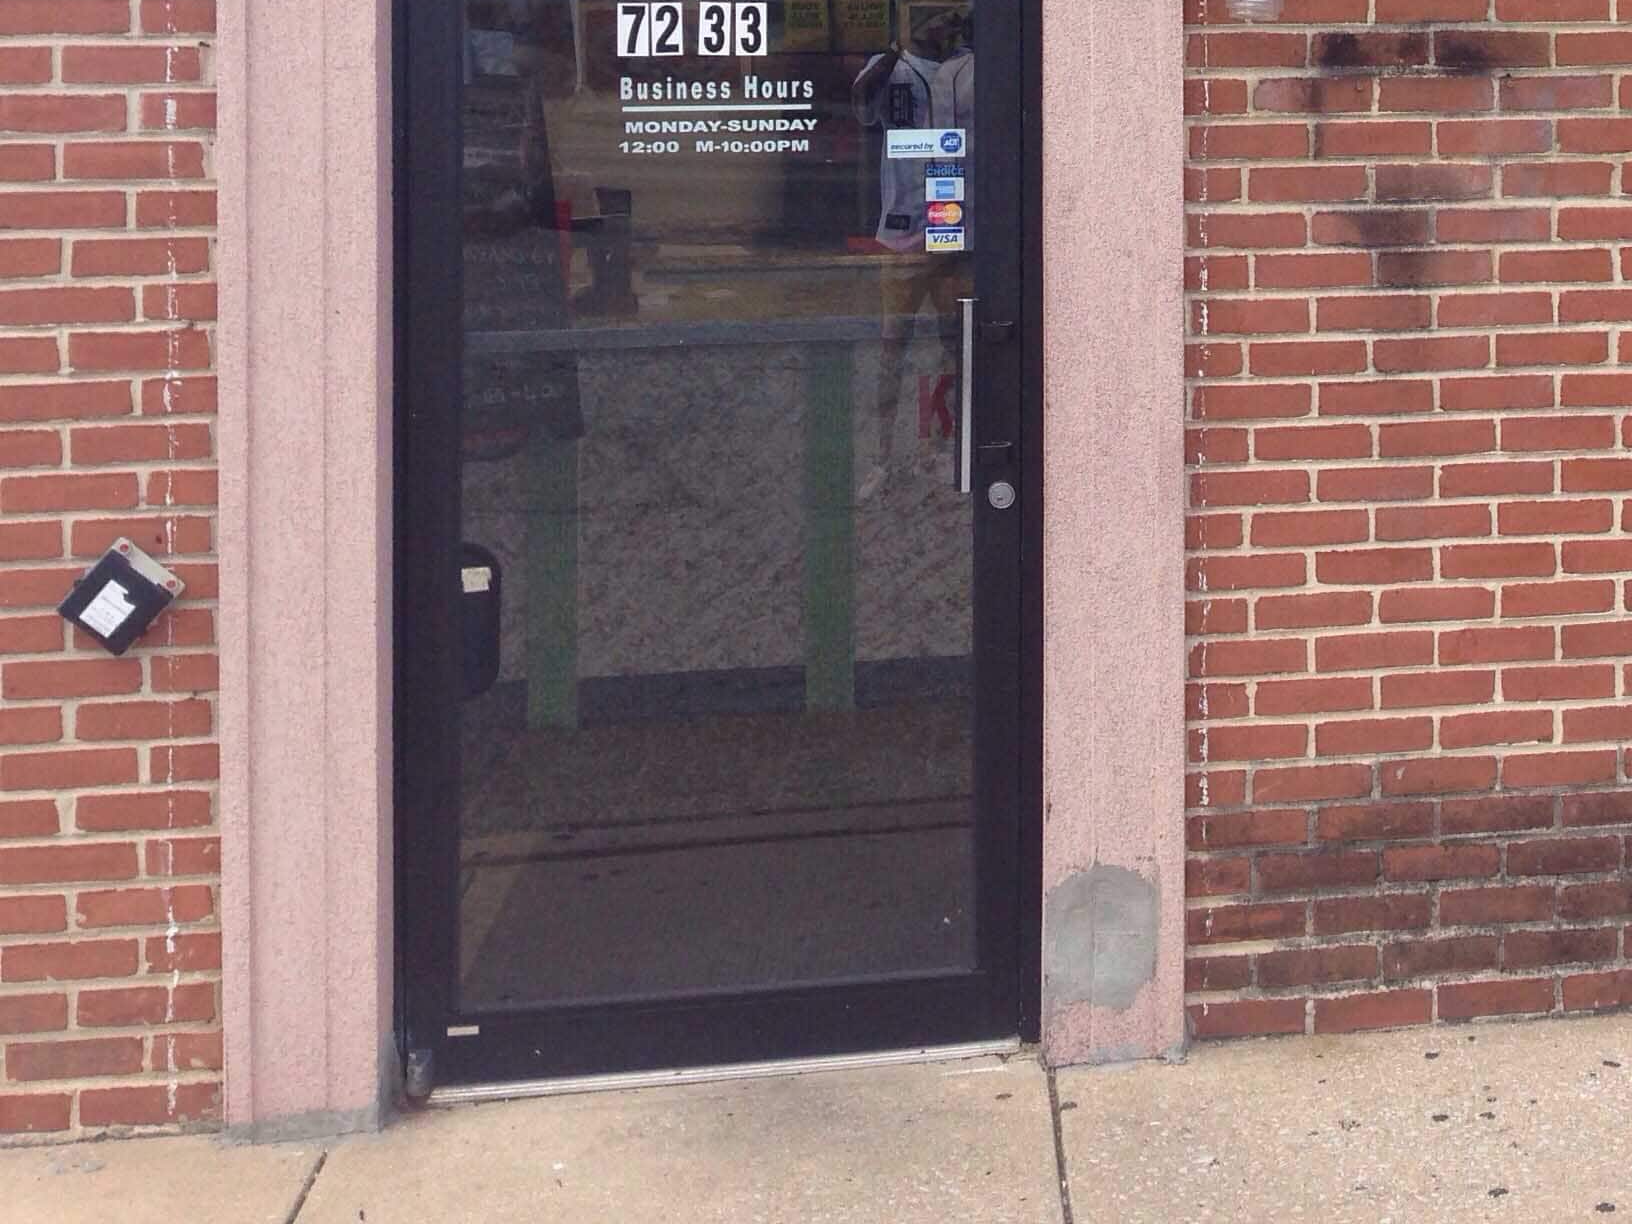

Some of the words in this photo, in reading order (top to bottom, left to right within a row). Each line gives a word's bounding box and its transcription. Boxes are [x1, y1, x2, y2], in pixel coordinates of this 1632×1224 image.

[620, 76, 731, 100] Business
[744, 75, 814, 99] Hours
[625, 119, 818, 134] MONDAY-SUNDAY
[618, 140, 680, 153] 12:00
[932, 234, 958, 244] VISA
